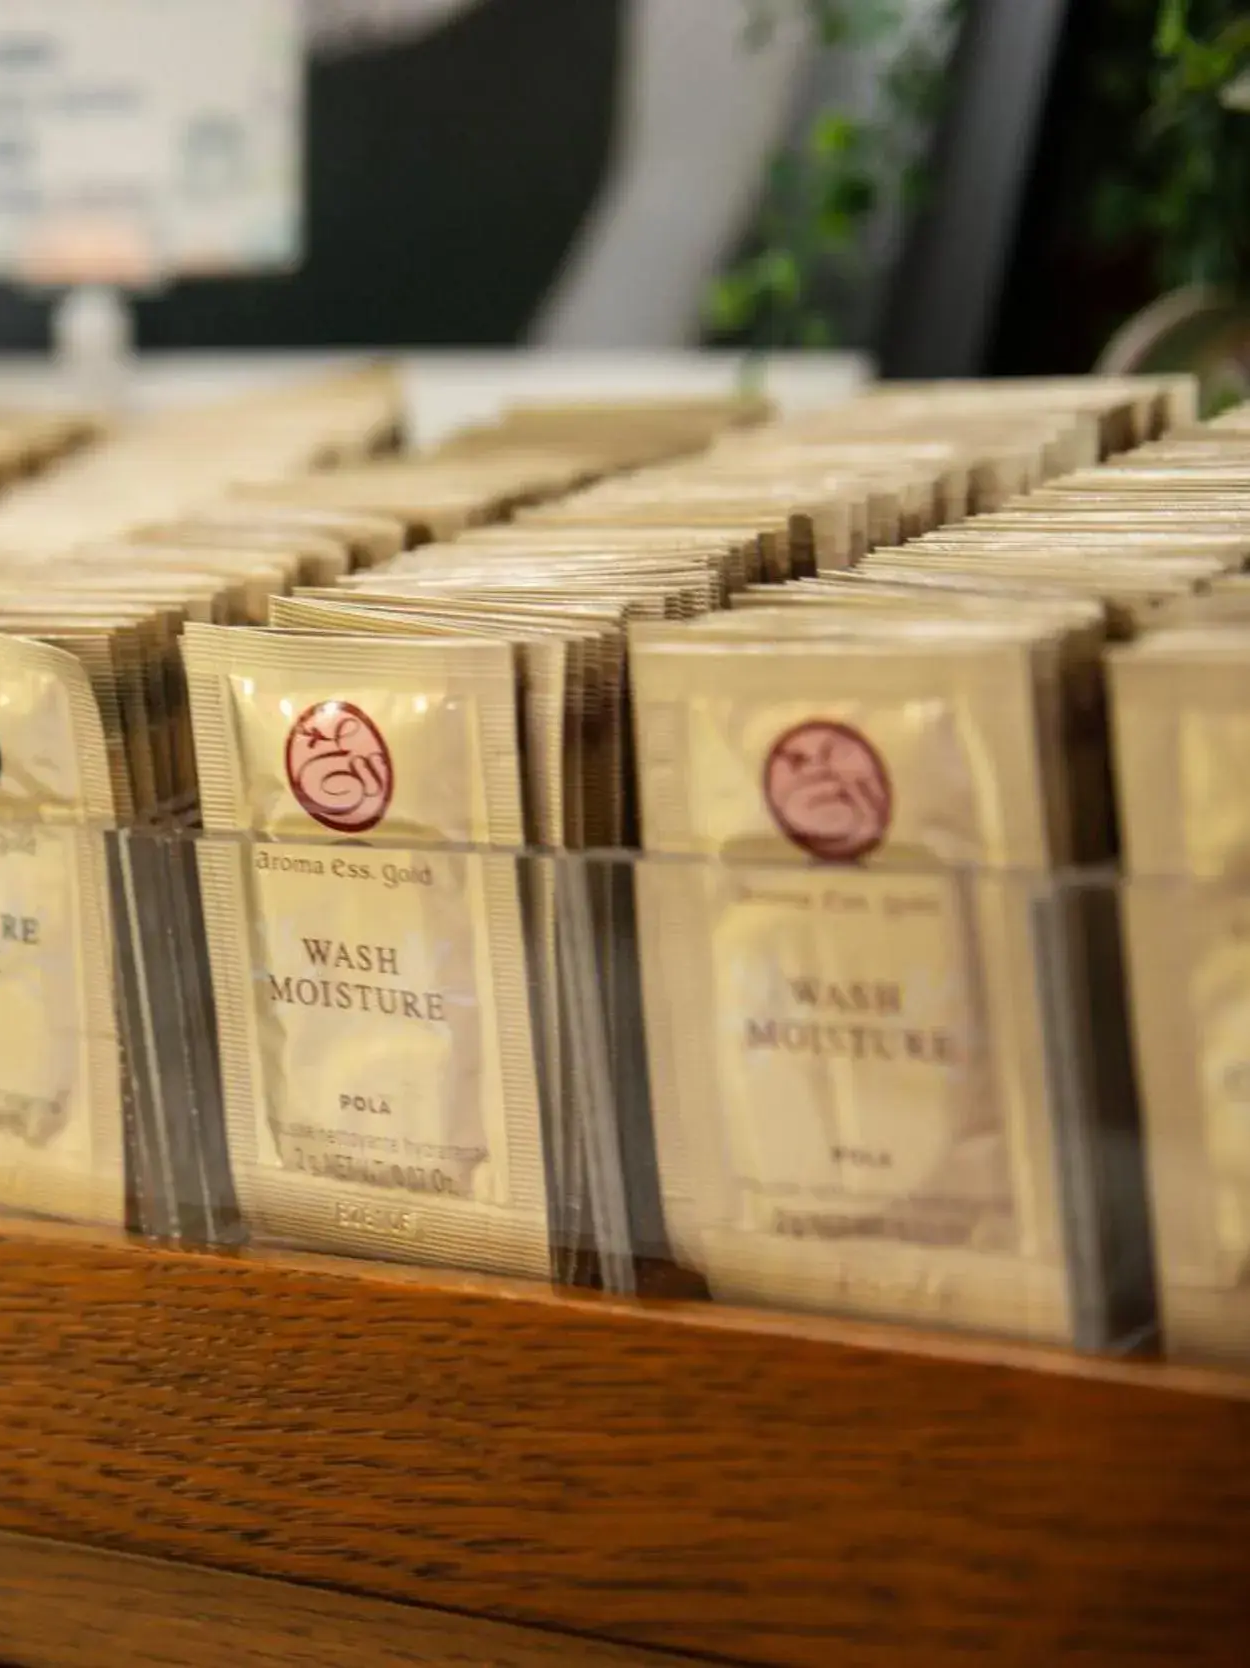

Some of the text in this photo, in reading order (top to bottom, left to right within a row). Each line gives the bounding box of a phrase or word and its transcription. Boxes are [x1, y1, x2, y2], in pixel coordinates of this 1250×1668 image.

[255, 851, 433, 889] aroma ess. gold
[302, 937, 401, 975] WASH
[268, 974, 446, 1021] MOISTURE
[788, 976, 903, 1018] WASH
[744, 1017, 956, 1066] MOISTURE
[339, 1093, 392, 1115] POLA
